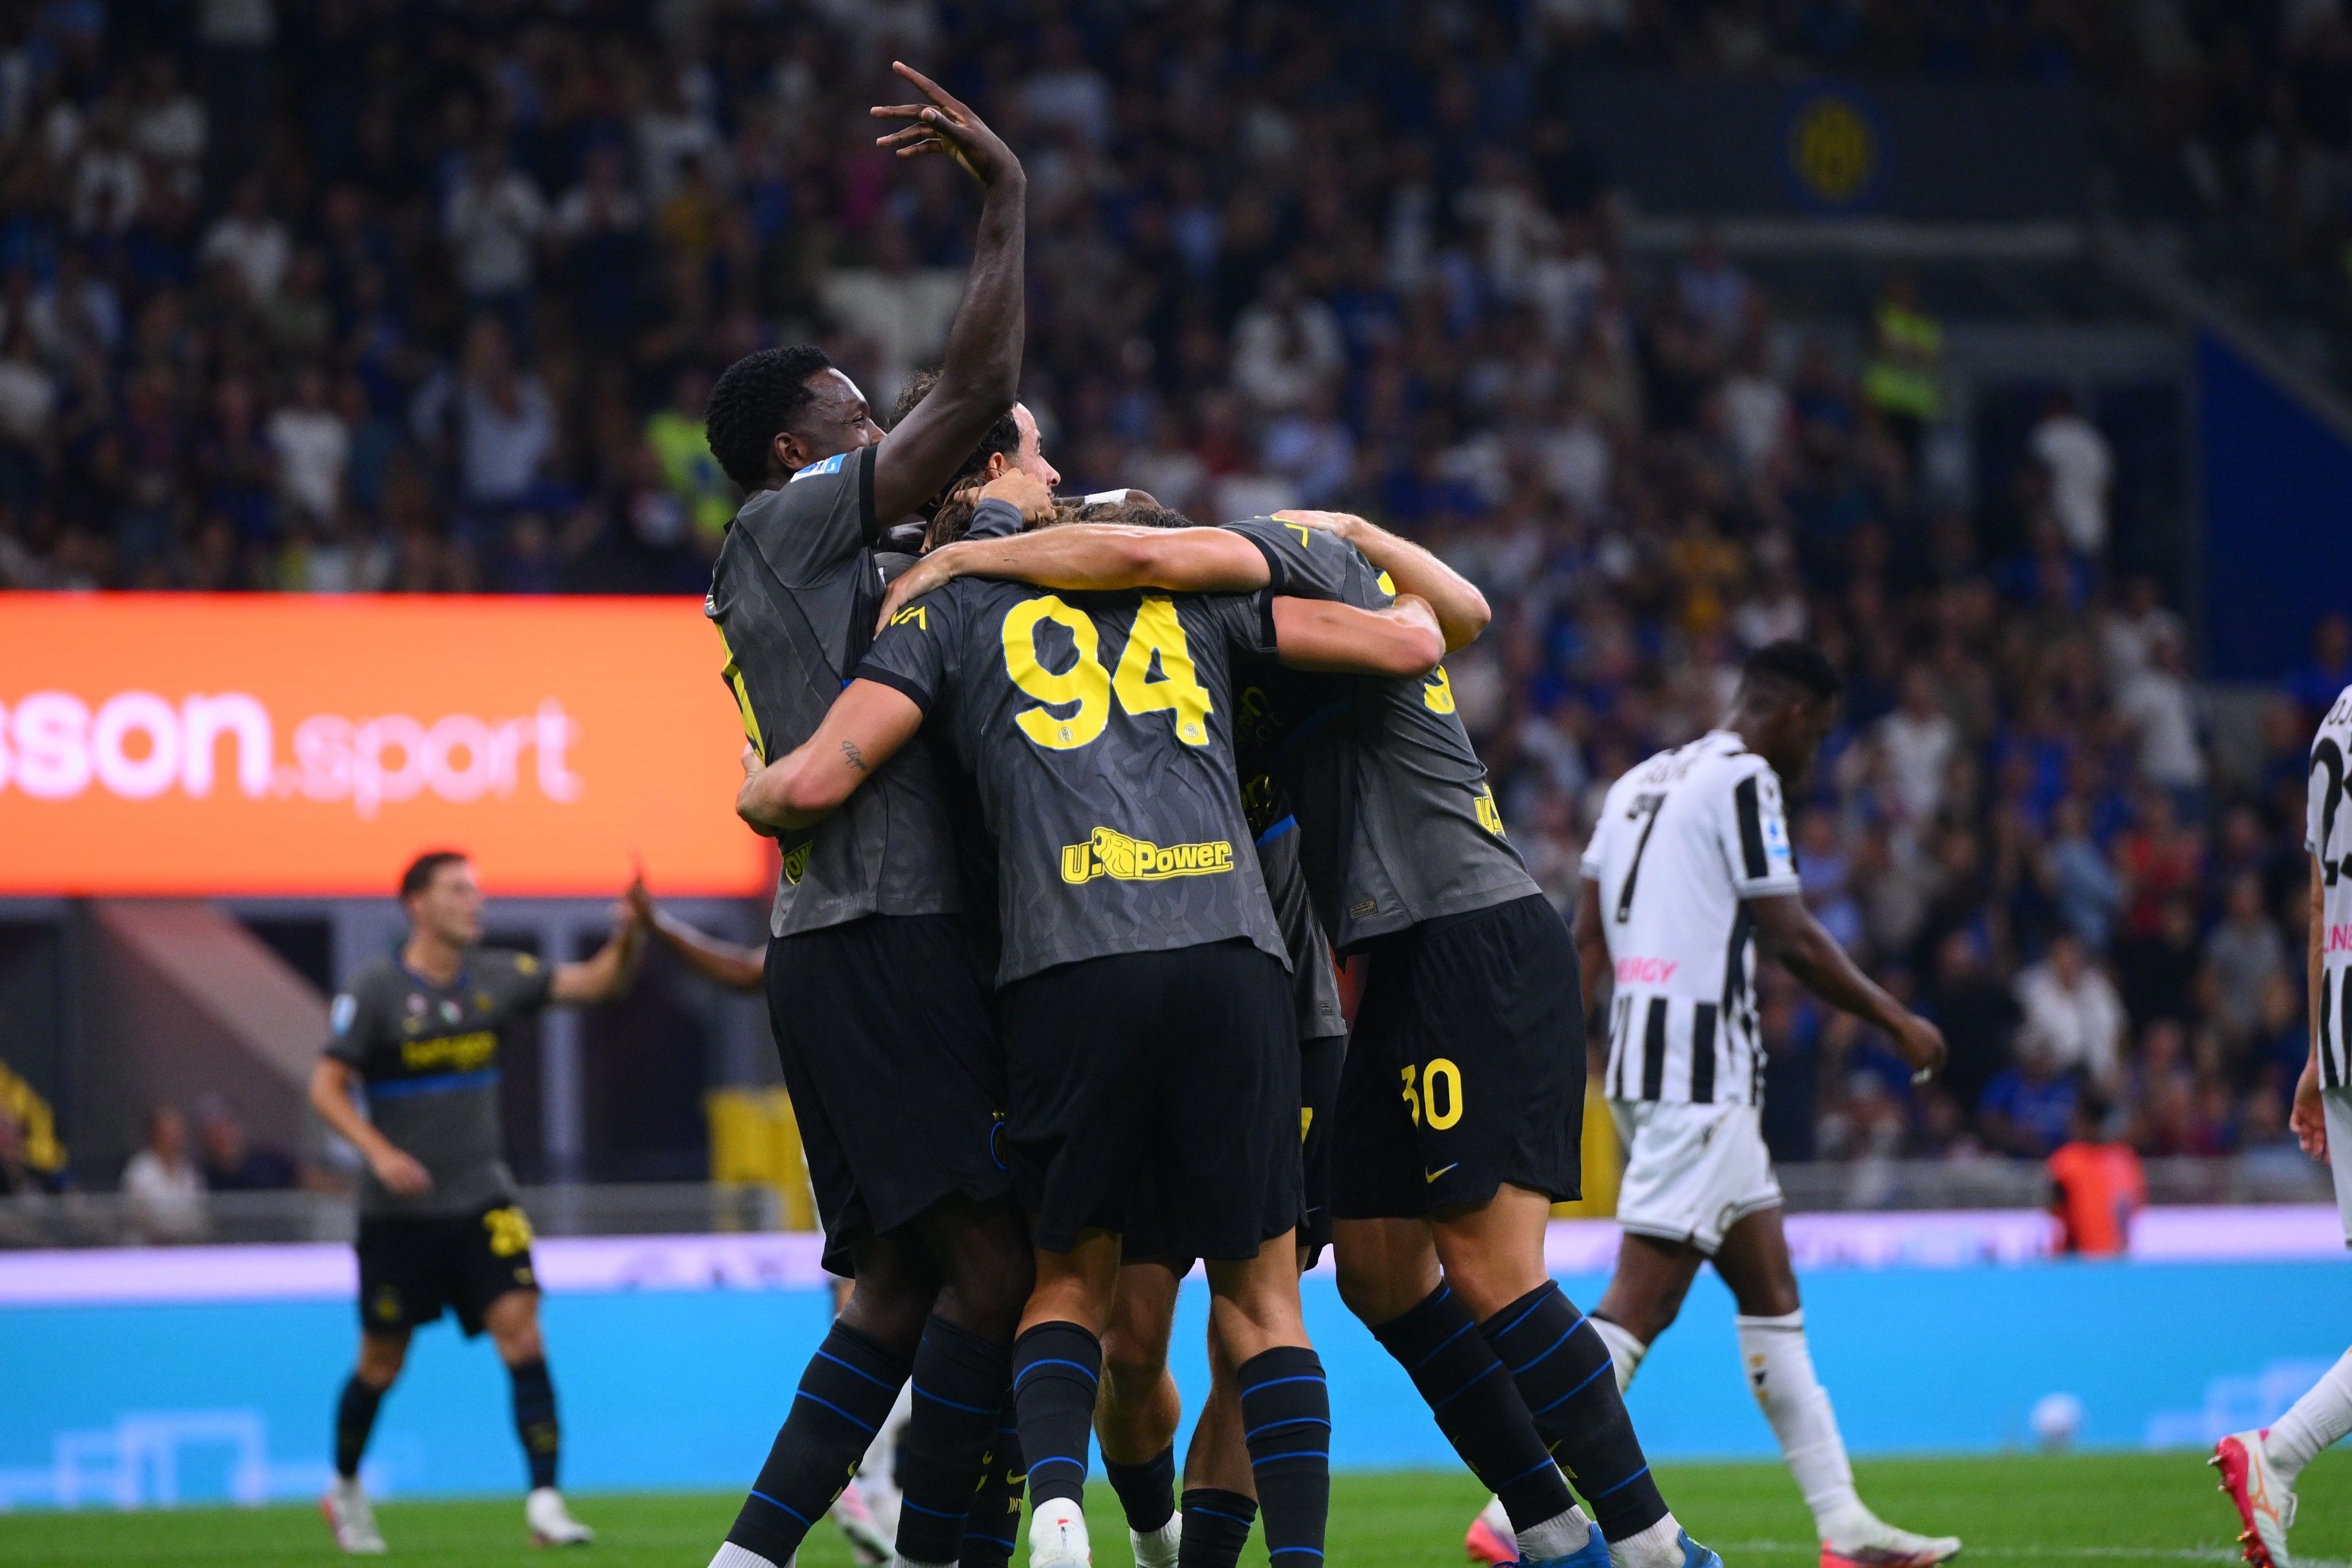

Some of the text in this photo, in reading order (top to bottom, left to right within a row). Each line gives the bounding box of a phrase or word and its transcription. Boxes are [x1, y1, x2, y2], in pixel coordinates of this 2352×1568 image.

[1002, 595, 1214, 750] 94
[0, 689, 581, 819] son.sport
[1615, 790, 1669, 926] 7
[1400, 1058, 1464, 1132] 30
